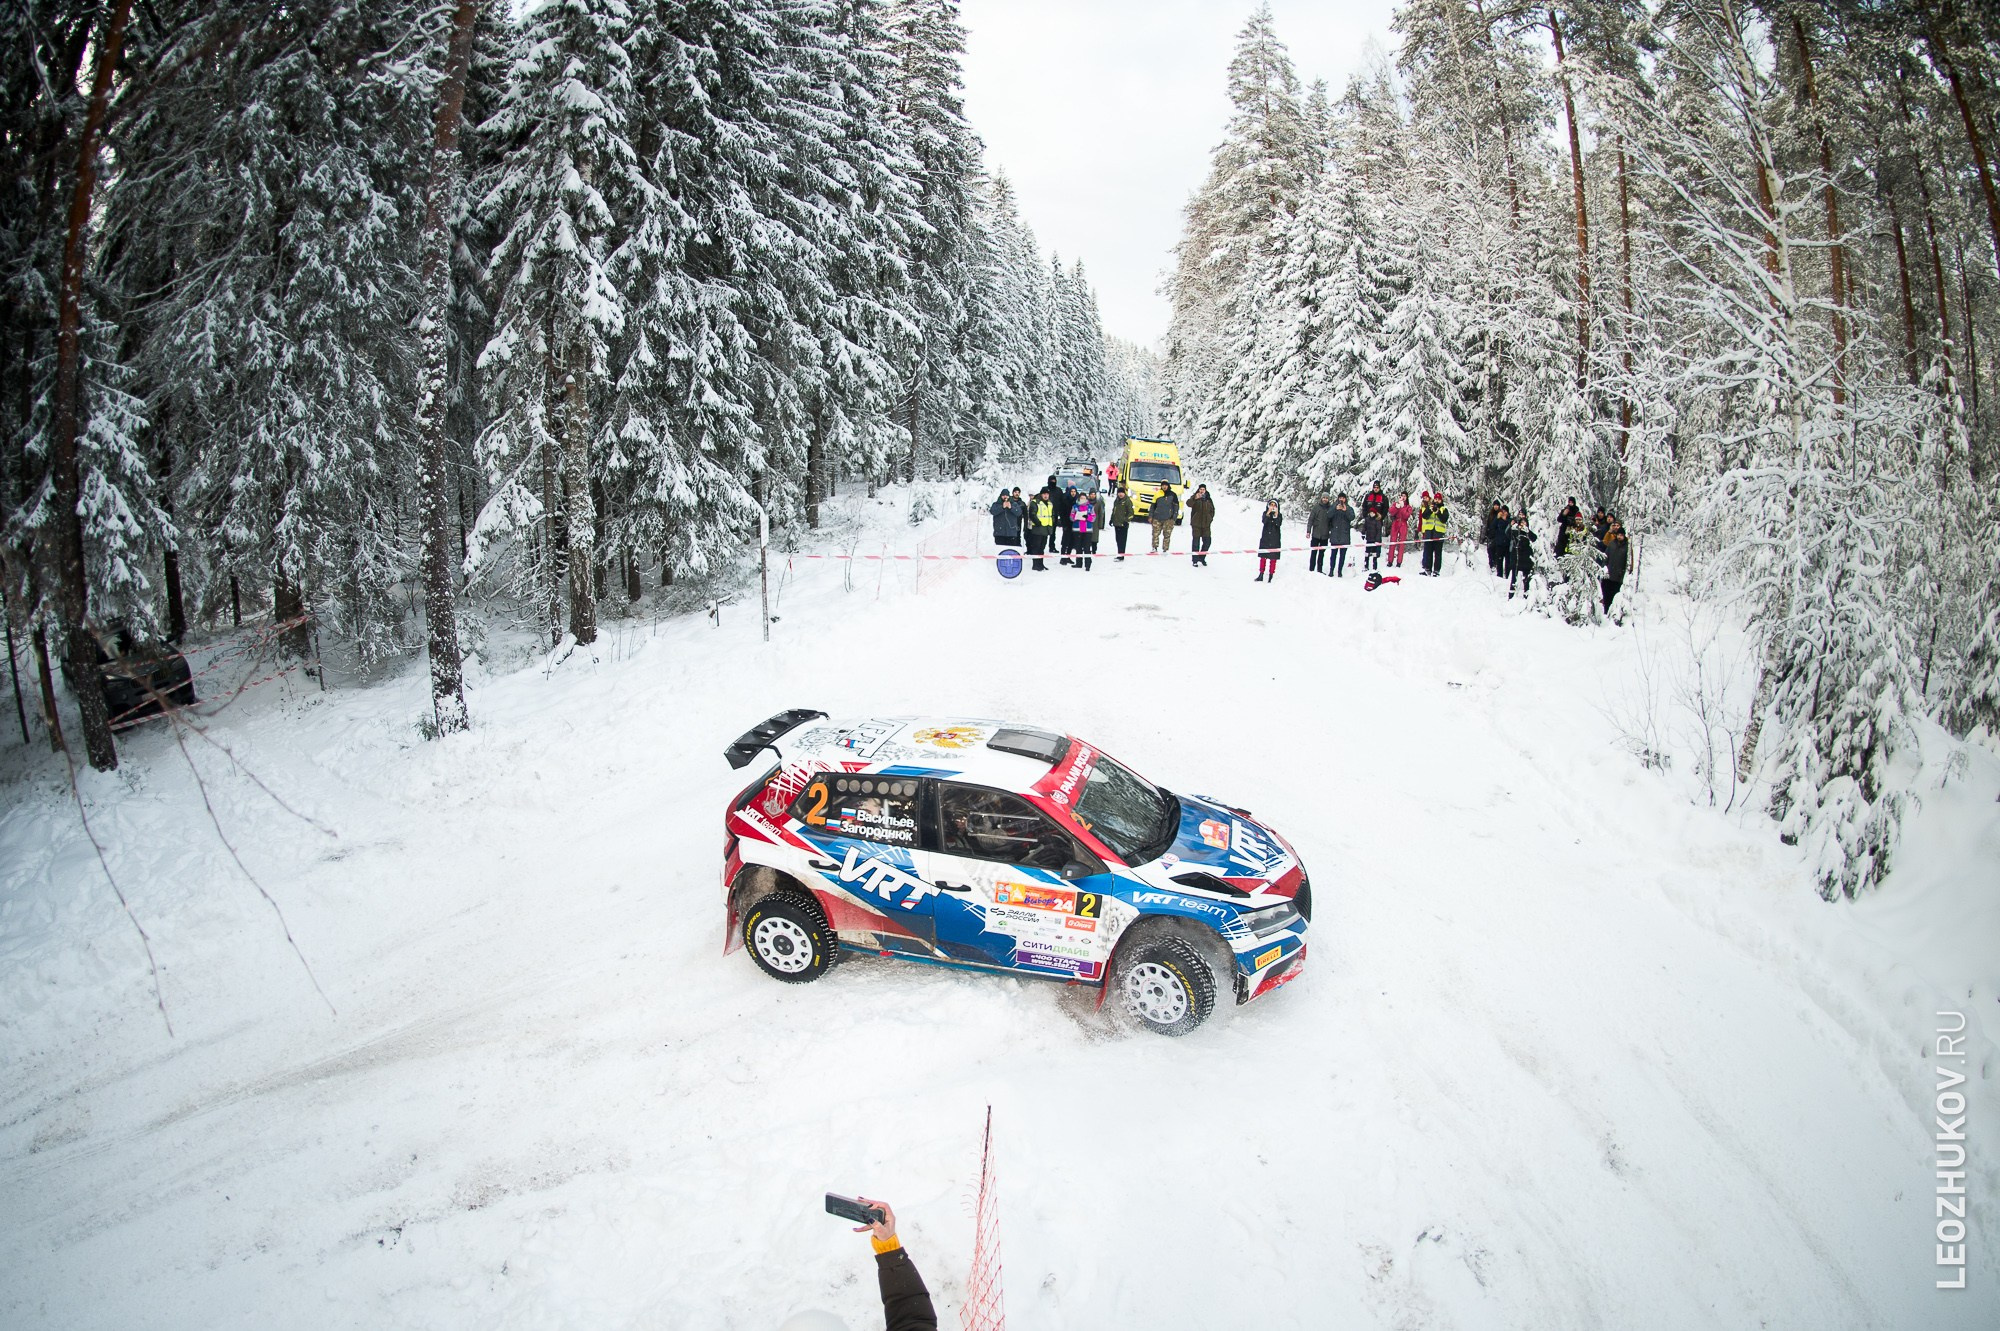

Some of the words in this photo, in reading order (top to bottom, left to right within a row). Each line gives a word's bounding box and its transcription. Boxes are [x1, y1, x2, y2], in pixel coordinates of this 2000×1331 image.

[806, 782, 829, 825] 2
[745, 804, 765, 821] VRT
[760, 817, 782, 836] team
[840, 820, 913, 841] Загороднюк
[856, 809, 915, 829] Васильев
[838, 845, 942, 910] VRT
[1052, 898, 1074, 912] 24
[1080, 893, 1096, 918] 2
[1132, 891, 1180, 904] VRT
[1179, 897, 1229, 918] team
[1022, 940, 1090, 957] СИТИДРАЙВ
